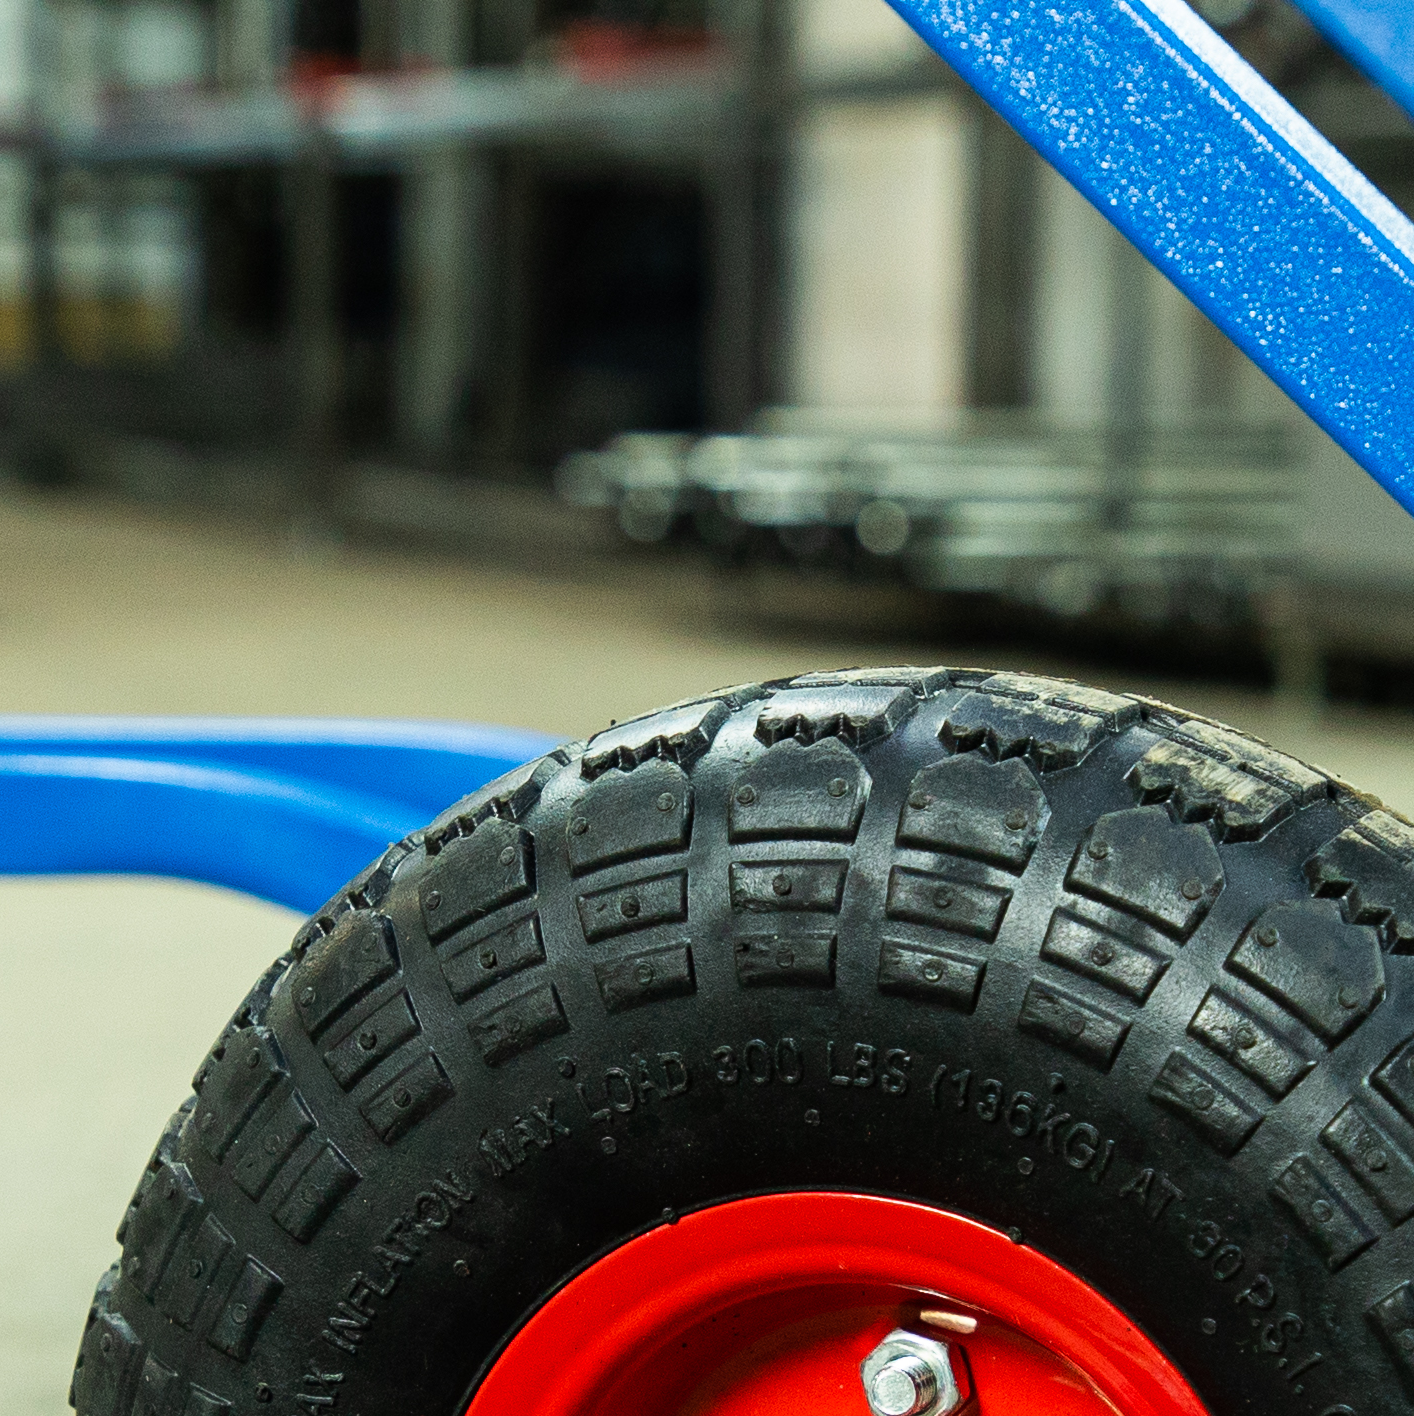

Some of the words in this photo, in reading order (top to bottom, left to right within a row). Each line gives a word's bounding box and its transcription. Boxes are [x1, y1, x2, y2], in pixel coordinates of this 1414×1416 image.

[322, 1168, 477, 1357] INFLATION
[479, 1097, 571, 1177] MAX
[576, 1050, 689, 1123] LOAD
[711, 1037, 805, 1085] 300
[825, 1038, 913, 1096] LBS
[1118, 1167, 1185, 1222] AT
[1187, 1219, 1245, 1282] 30
